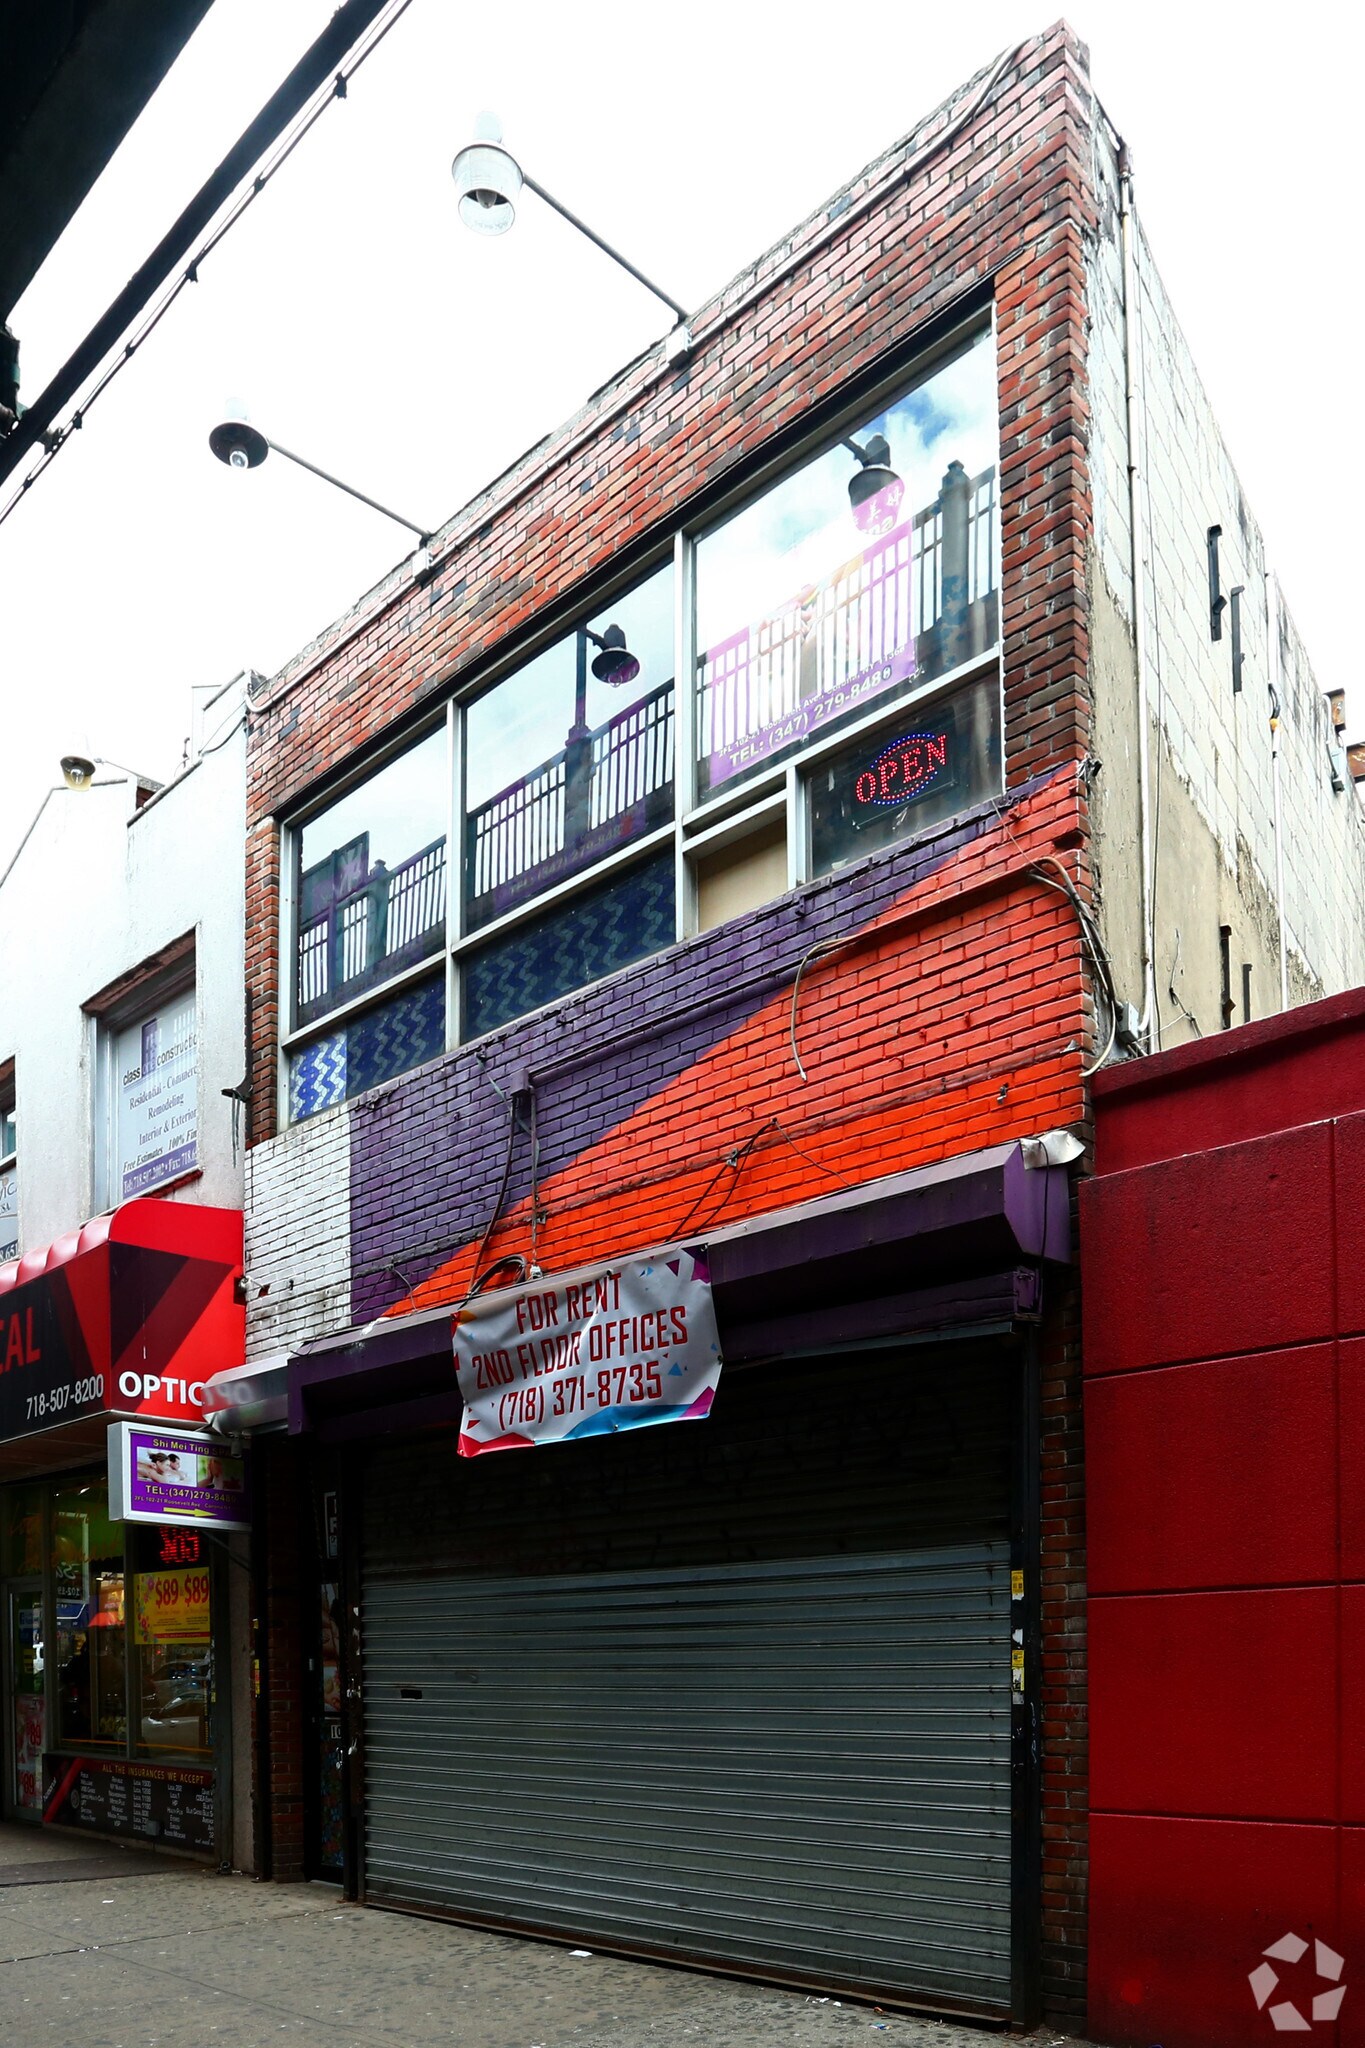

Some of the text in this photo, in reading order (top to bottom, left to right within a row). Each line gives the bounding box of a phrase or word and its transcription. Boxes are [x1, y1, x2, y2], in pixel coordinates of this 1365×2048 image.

[730, 741, 764, 767] TEL:
[768, 712, 809, 749] (347)
[854, 733, 948, 804] OPEN
[123, 1067, 140, 1086] class
[129, 1083, 162, 1110] Residential
[148, 1093, 184, 1120] Remodeling
[139, 1126, 162, 1145] Interior
[163, 1120, 170, 1133] &
[123, 1160, 136, 1174] Free
[136, 1145, 163, 1166] Estimates
[168, 1134, 185, 1151] 100%
[515, 1273, 622, 1334] FOR RENT
[471, 1305, 688, 1390] 2ND FLOOR OFFICES
[26, 1373, 104, 1420] 718-507-8200
[498, 1360, 663, 1431] (718) 371-8735
[153, 1438, 168, 1448] Shi
[170, 1441, 187, 1450] Mei
[189, 1443, 209, 1455] Ting
[155, 1574, 209, 1609] $89 $89
[102, 1764, 112, 1773] ALL
[115, 1765, 126, 1775] THE
[127, 1766, 165, 1780] INSURANCES
[167, 1772, 177, 1782] WE
[180, 1773, 204, 1785] ACCEPT
